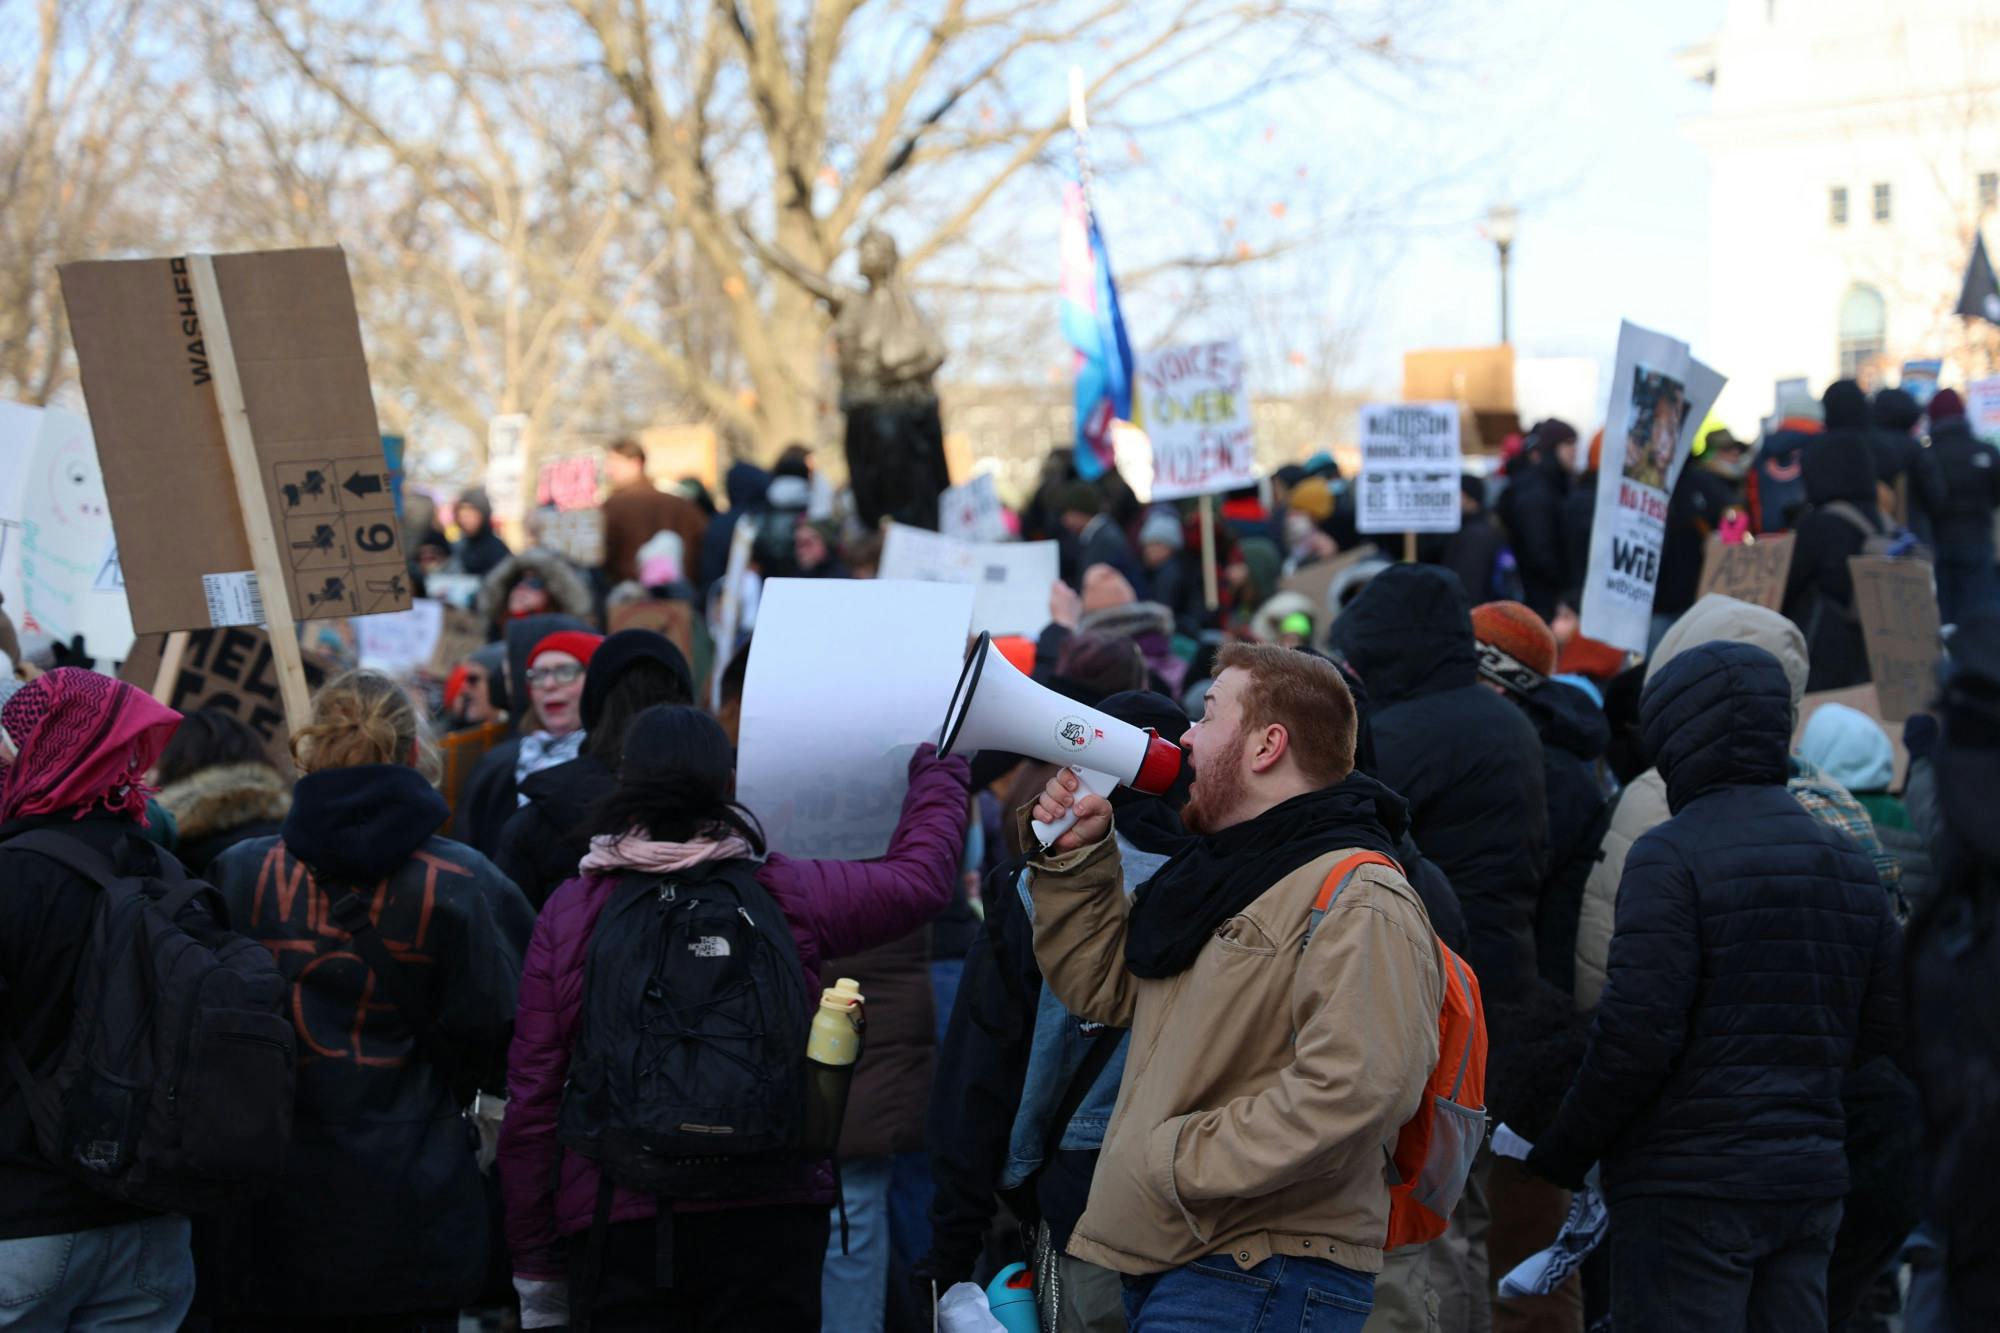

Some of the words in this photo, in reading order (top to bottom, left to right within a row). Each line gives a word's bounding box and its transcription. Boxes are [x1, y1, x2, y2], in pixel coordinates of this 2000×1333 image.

[1151, 389, 1237, 426] OVER
[688, 943, 717, 951] NORTH
[695, 949, 717, 957] FACE
